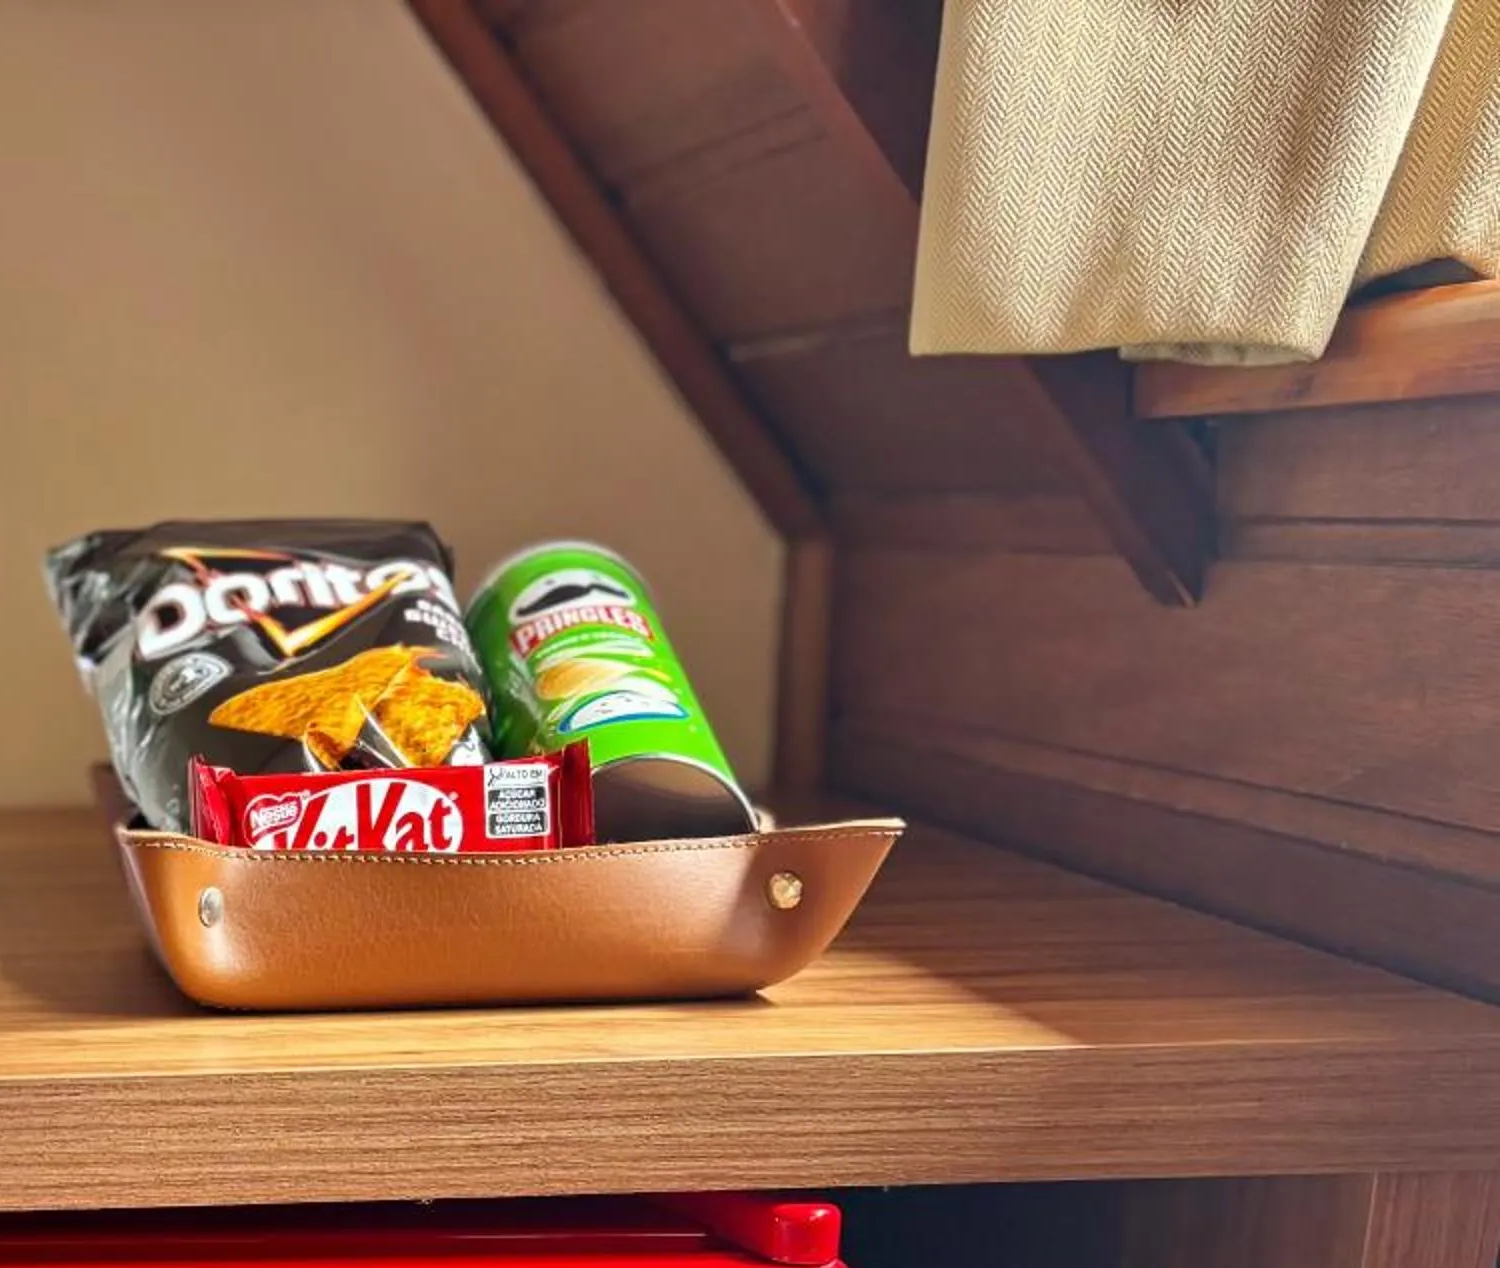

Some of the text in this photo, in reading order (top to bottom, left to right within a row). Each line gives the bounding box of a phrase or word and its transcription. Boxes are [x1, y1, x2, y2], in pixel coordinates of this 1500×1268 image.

[138, 561, 461, 661] Doritos
[515, 605, 651, 656] PRINGLES
[270, 782, 452, 851] KKat
